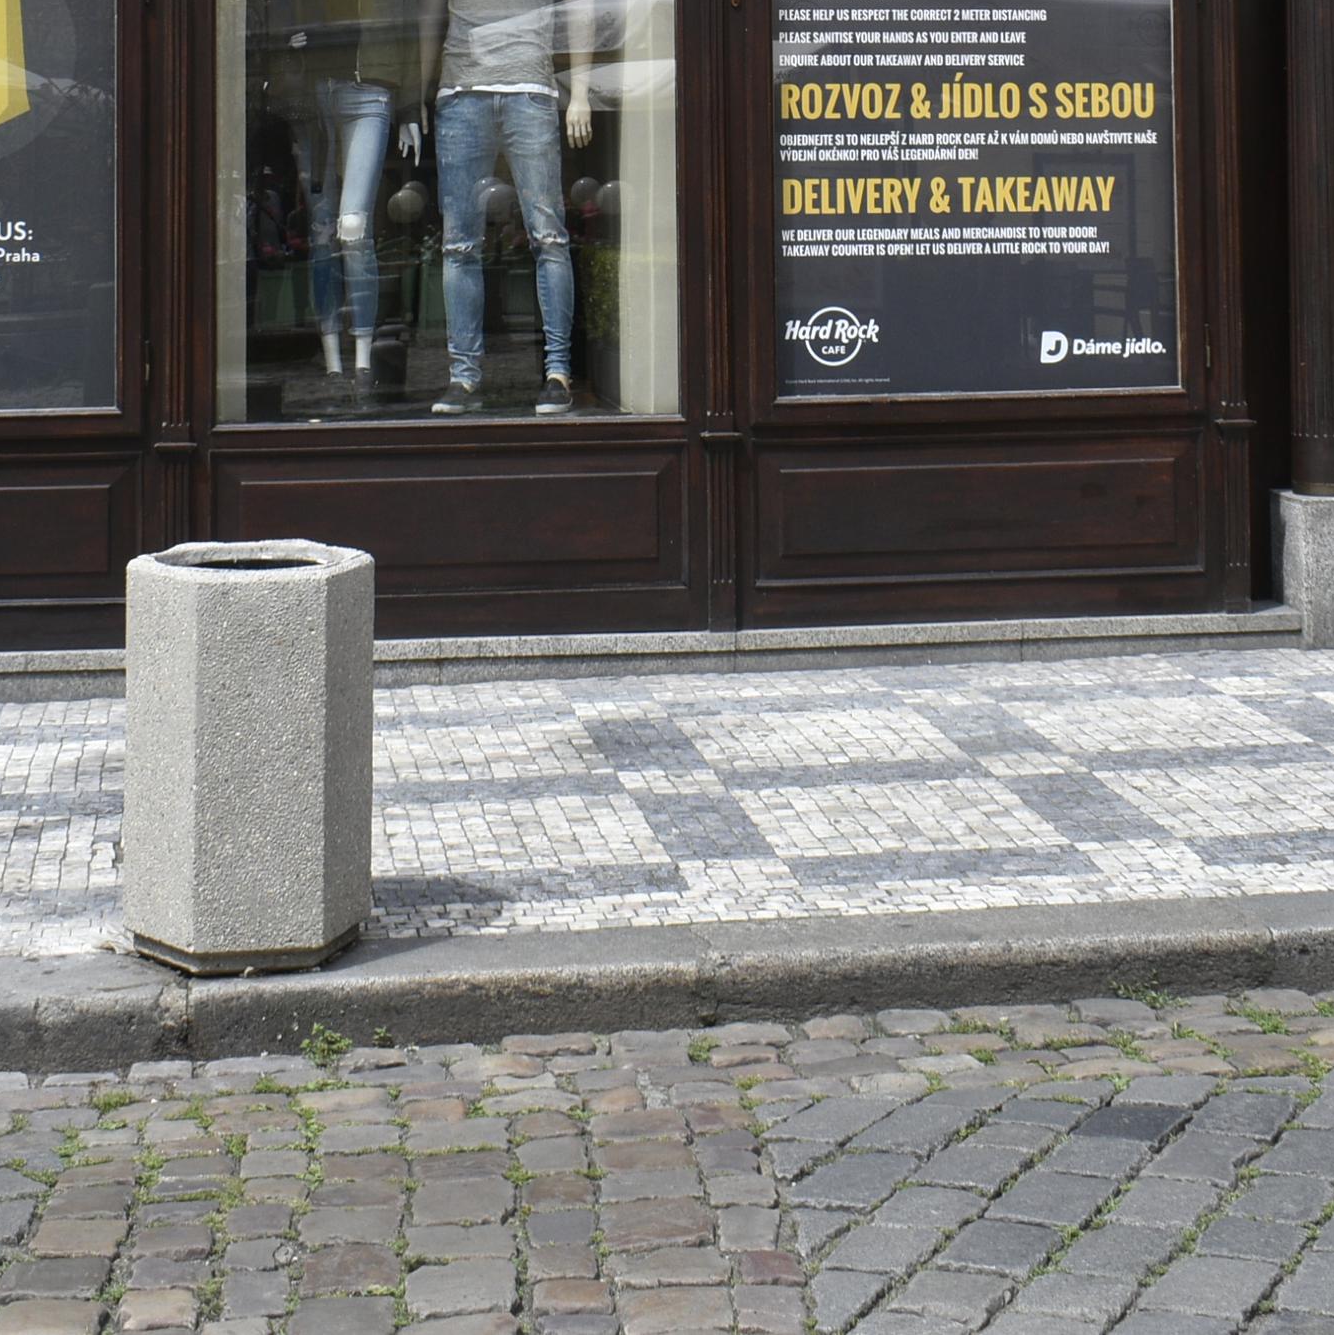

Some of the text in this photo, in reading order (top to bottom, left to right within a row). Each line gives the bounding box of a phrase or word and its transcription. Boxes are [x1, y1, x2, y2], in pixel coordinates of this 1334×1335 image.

[778, 31, 1025, 44] PLEASE SANITISE YOUR HANDS AS YOU ENTER AND LEAVE
[781, 72, 1153, 120] ROZVOZ & JÍDLO S SEBOU
[783, 175, 1114, 214] DELIVERY & TAKEAWAY
[784, 318, 879, 344] Hard Rock
[821, 345, 846, 355] CAFE
[1072, 337, 1165, 358] Dáme jídlo.
